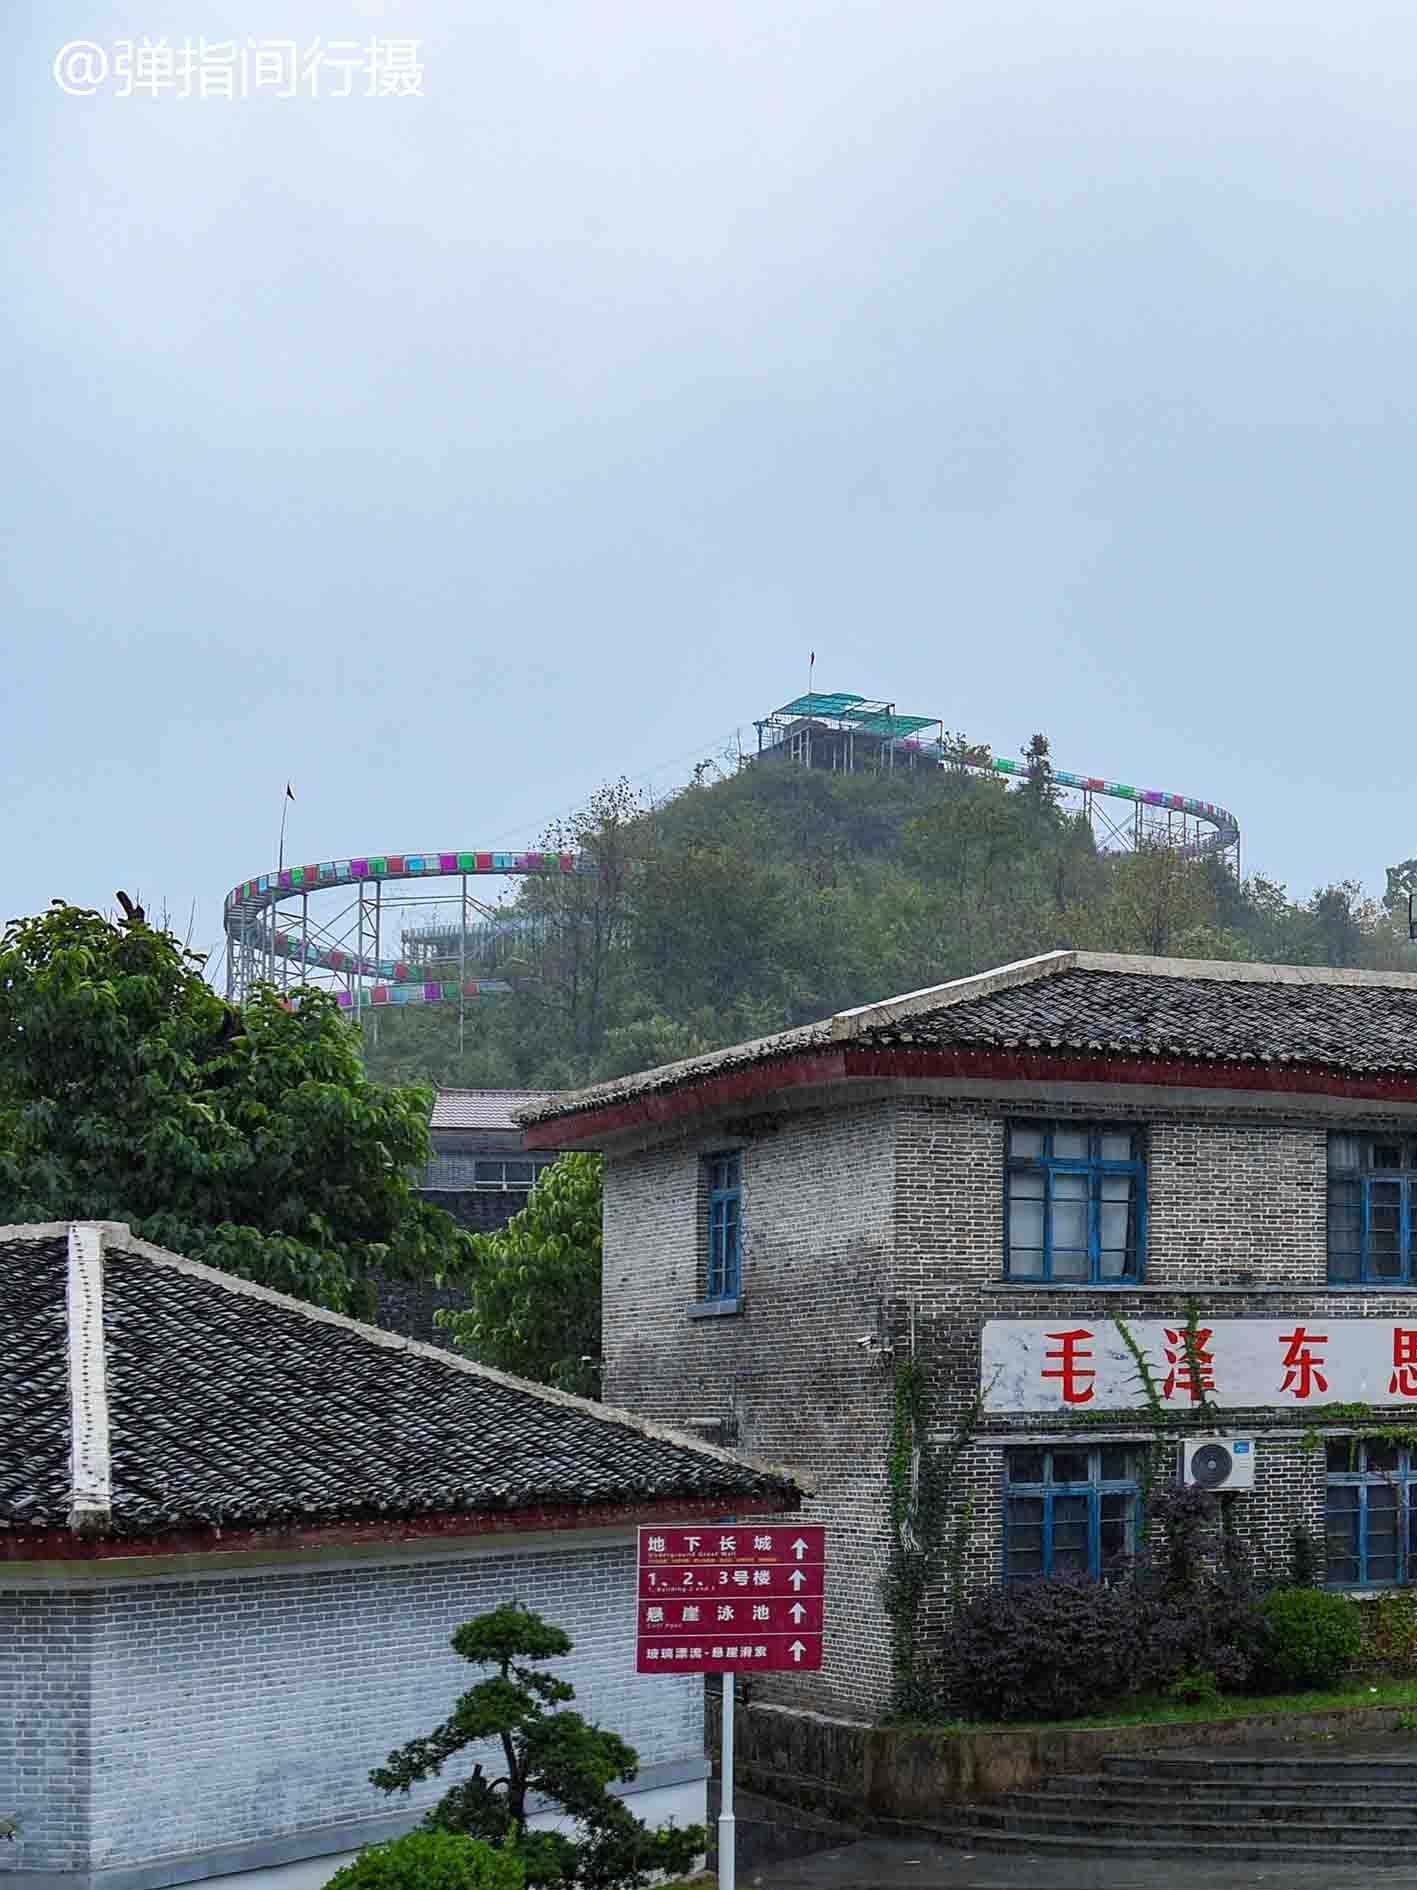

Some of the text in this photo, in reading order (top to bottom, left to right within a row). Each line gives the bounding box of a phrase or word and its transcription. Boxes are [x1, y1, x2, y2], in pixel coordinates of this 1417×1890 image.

[647, 1535, 772, 1552] 地下长城
[648, 1570, 771, 1586] 1、2、3号楼
[646, 1604, 770, 1622] 悬崖泳池
